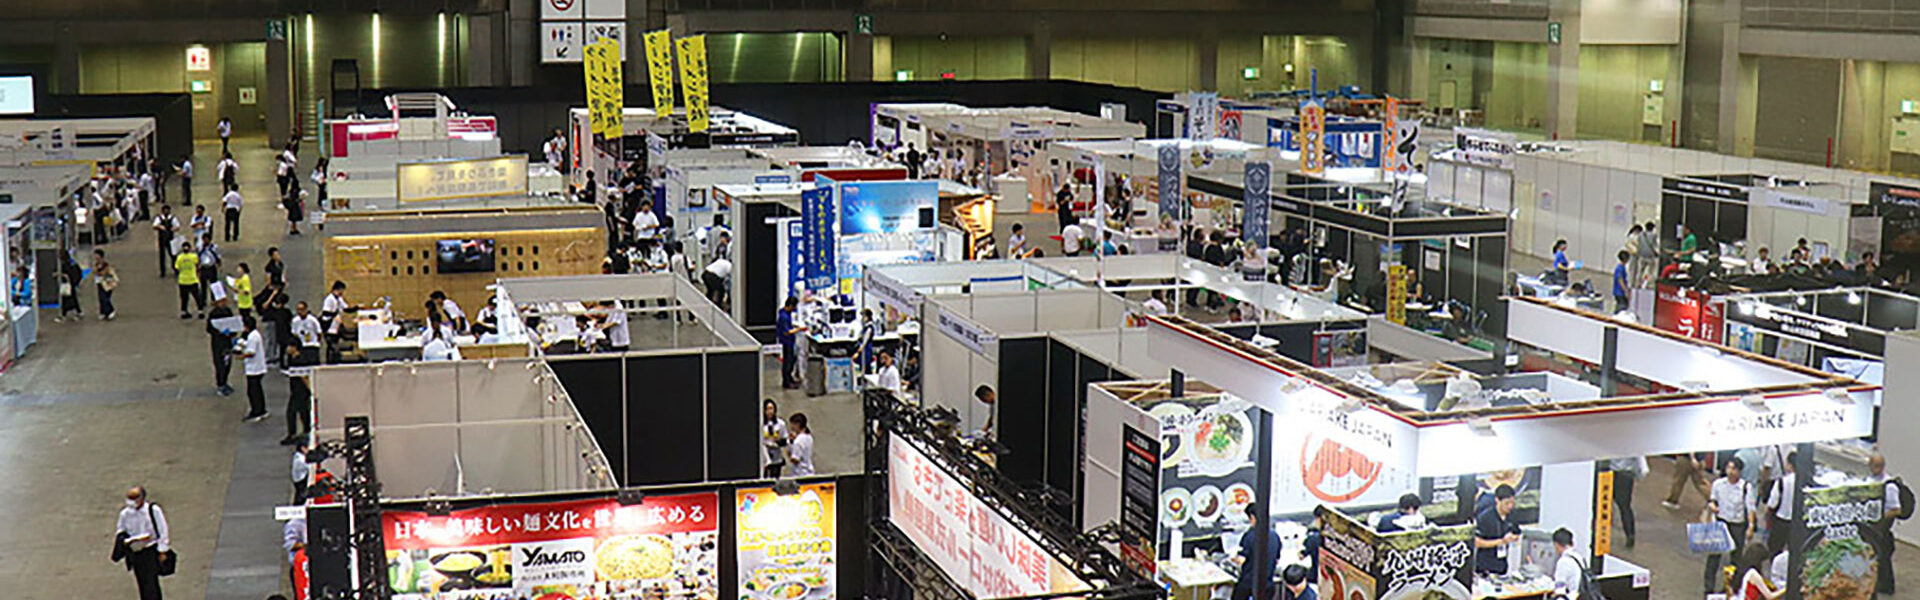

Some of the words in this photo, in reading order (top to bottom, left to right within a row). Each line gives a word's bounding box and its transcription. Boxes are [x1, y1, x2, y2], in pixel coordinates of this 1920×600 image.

[1790, 407, 1846, 428] JAPAN
[521, 546, 586, 567] YAMATO
[1390, 566, 1453, 593] ラーメン
